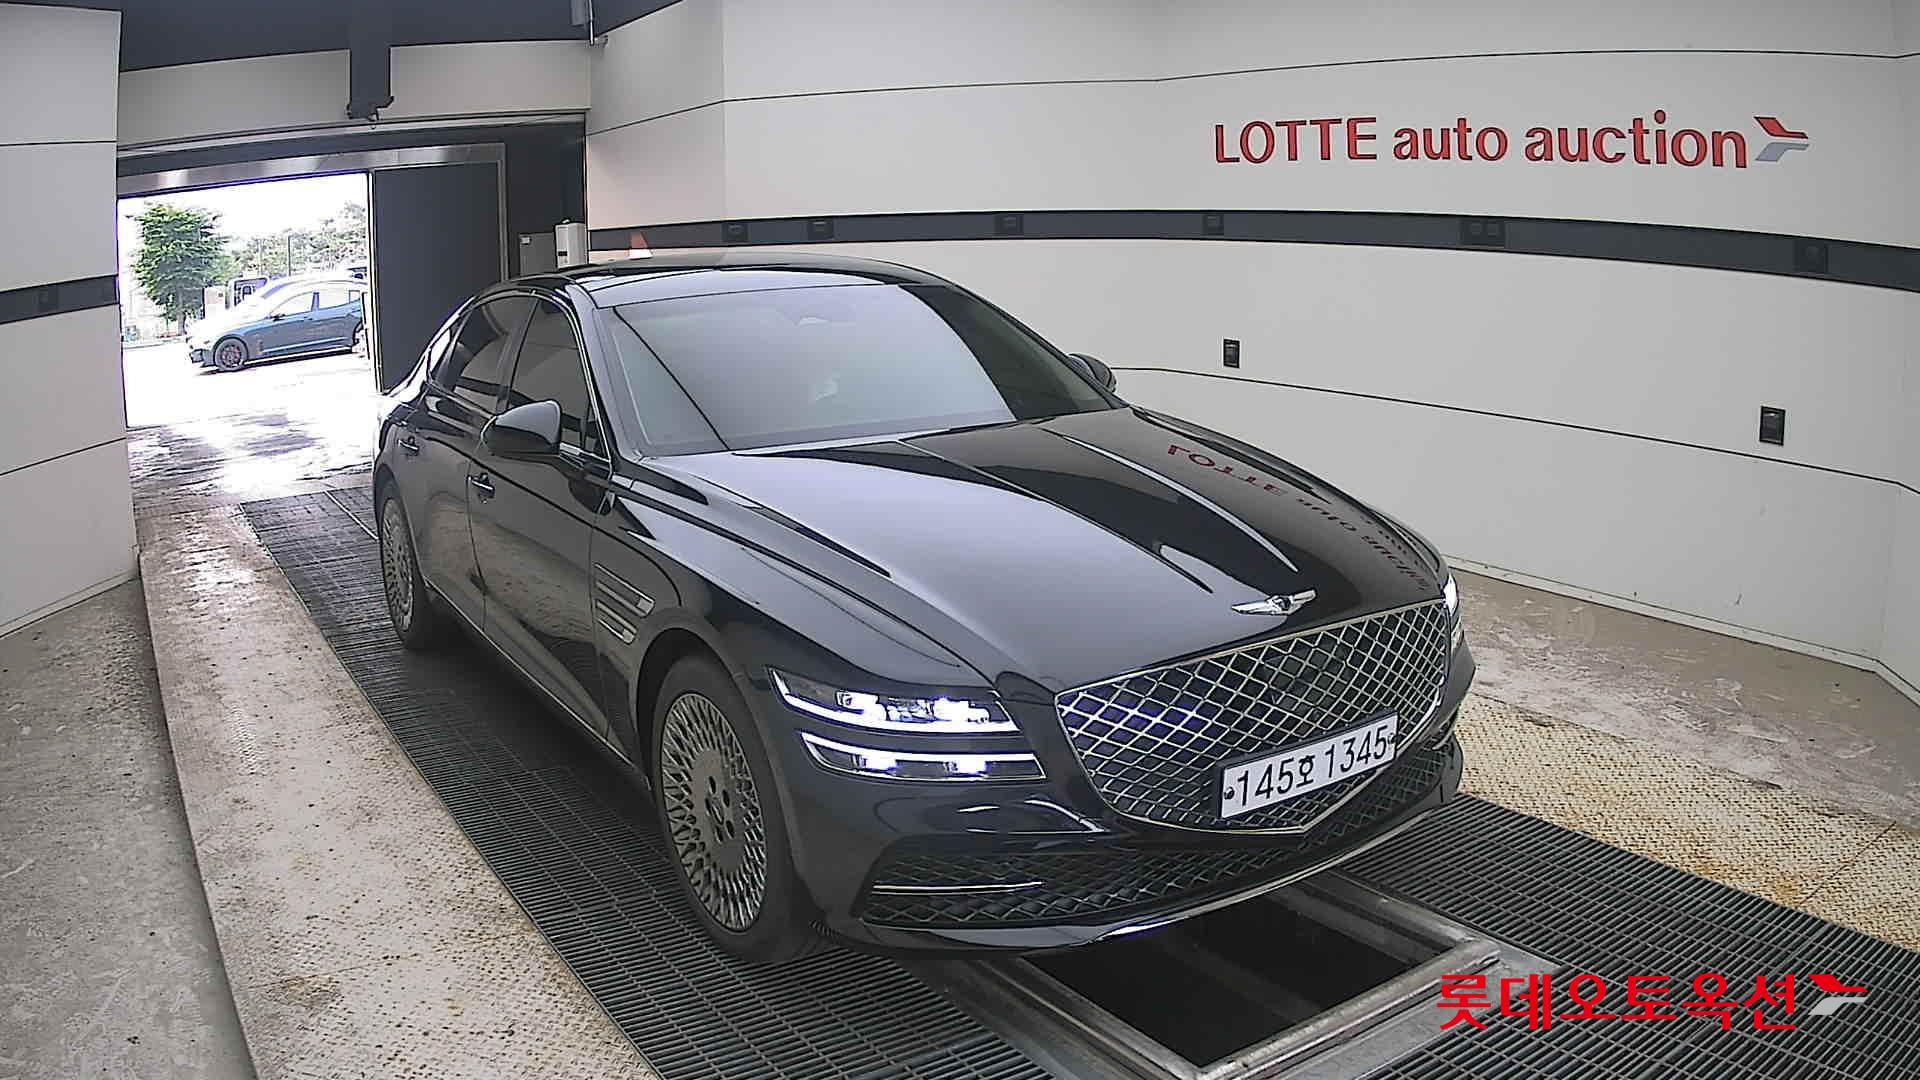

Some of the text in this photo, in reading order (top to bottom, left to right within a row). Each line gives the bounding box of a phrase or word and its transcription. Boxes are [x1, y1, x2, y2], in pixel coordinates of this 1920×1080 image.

[1215, 110, 1747, 168] LOTTE auto auction
[1237, 724, 1389, 807] 145호 1345
